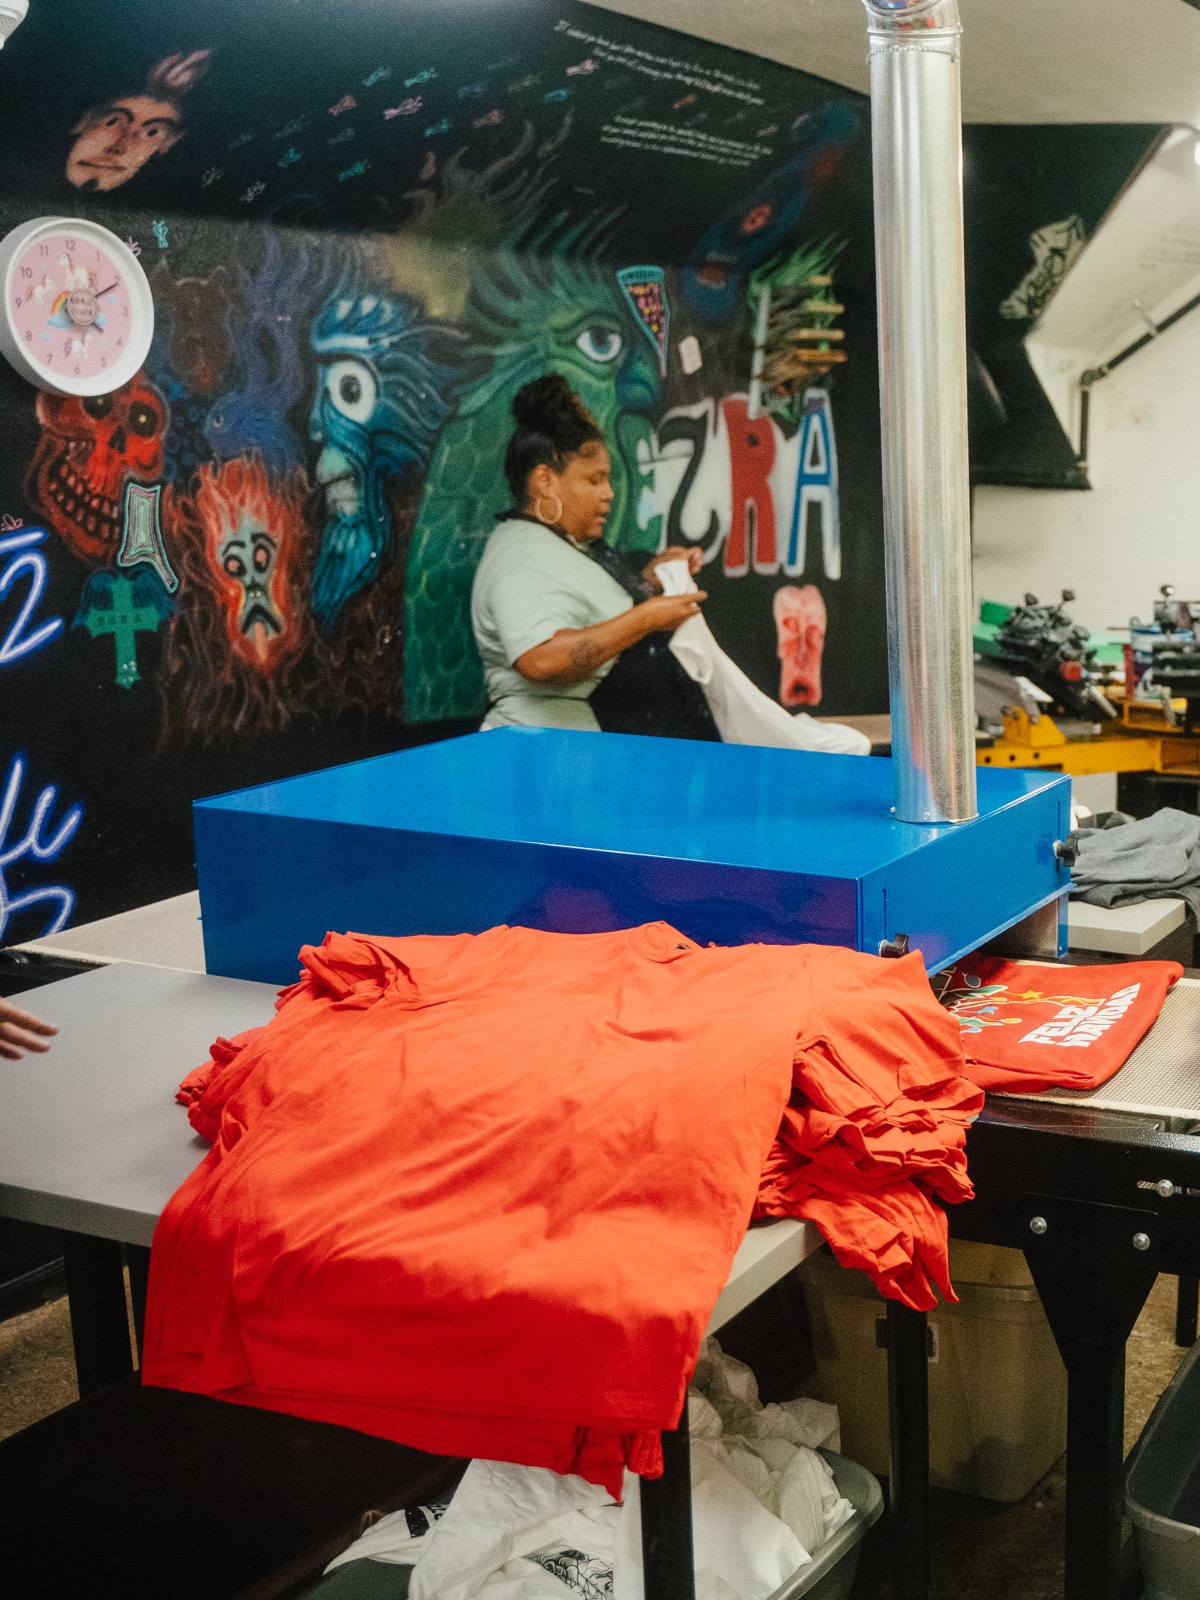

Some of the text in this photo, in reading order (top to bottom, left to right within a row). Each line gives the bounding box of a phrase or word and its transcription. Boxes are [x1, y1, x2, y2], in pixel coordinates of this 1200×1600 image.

[39, 245, 49, 257] 11
[65, 239, 77, 252] 12
[21, 266, 33, 279] 10
[15, 297, 22, 309] 9
[122, 305, 129, 317] 3
[25, 330, 33, 343] 8
[46, 354, 54, 365] 7
[74, 364, 81, 375] 6
[1056, 982, 1141, 1048] NAVIDAD
[1017, 1004, 1100, 1046] FELIZ
